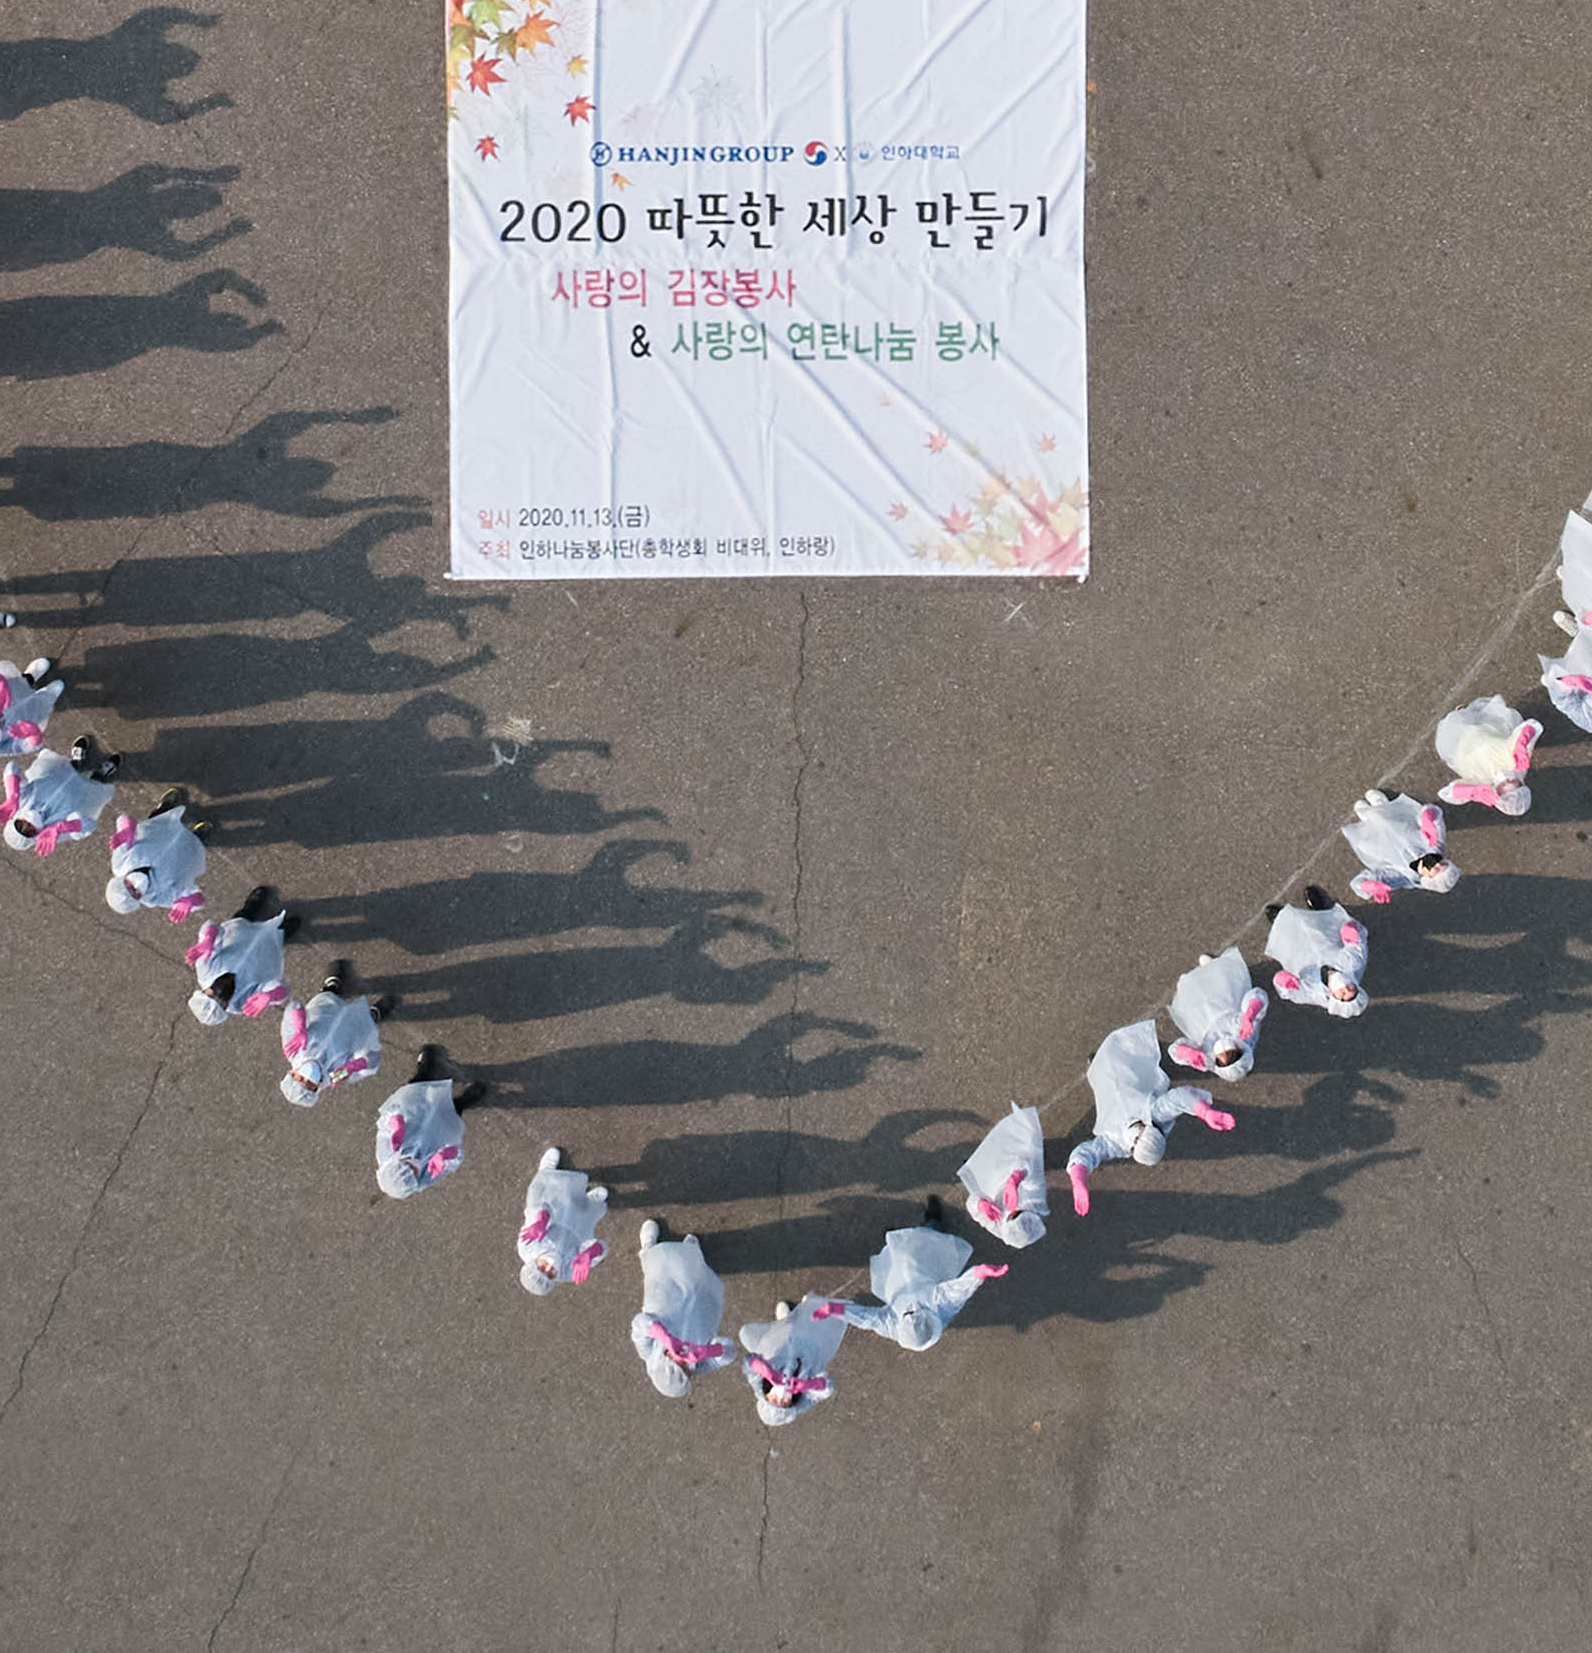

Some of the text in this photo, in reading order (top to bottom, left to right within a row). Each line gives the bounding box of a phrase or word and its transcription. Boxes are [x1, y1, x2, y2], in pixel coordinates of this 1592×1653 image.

[617, 146, 795, 165] HANJINGROUP
[880, 145, 961, 162] 인하대학교
[499, 191, 1048, 250] 2020 따뜻한 세상 만들기
[551, 268, 797, 308] 사랑의 김장봉사
[630, 321, 1000, 361] & 사랑의 연탄나눔 봉사
[477, 505, 650, 529] 일시 2020.11.13.(금)
[519, 537, 707, 560] 인하나눔봉사단(총학생회
[716, 537, 771, 557] 비대위,
[779, 536, 836, 557] 인하랑)
